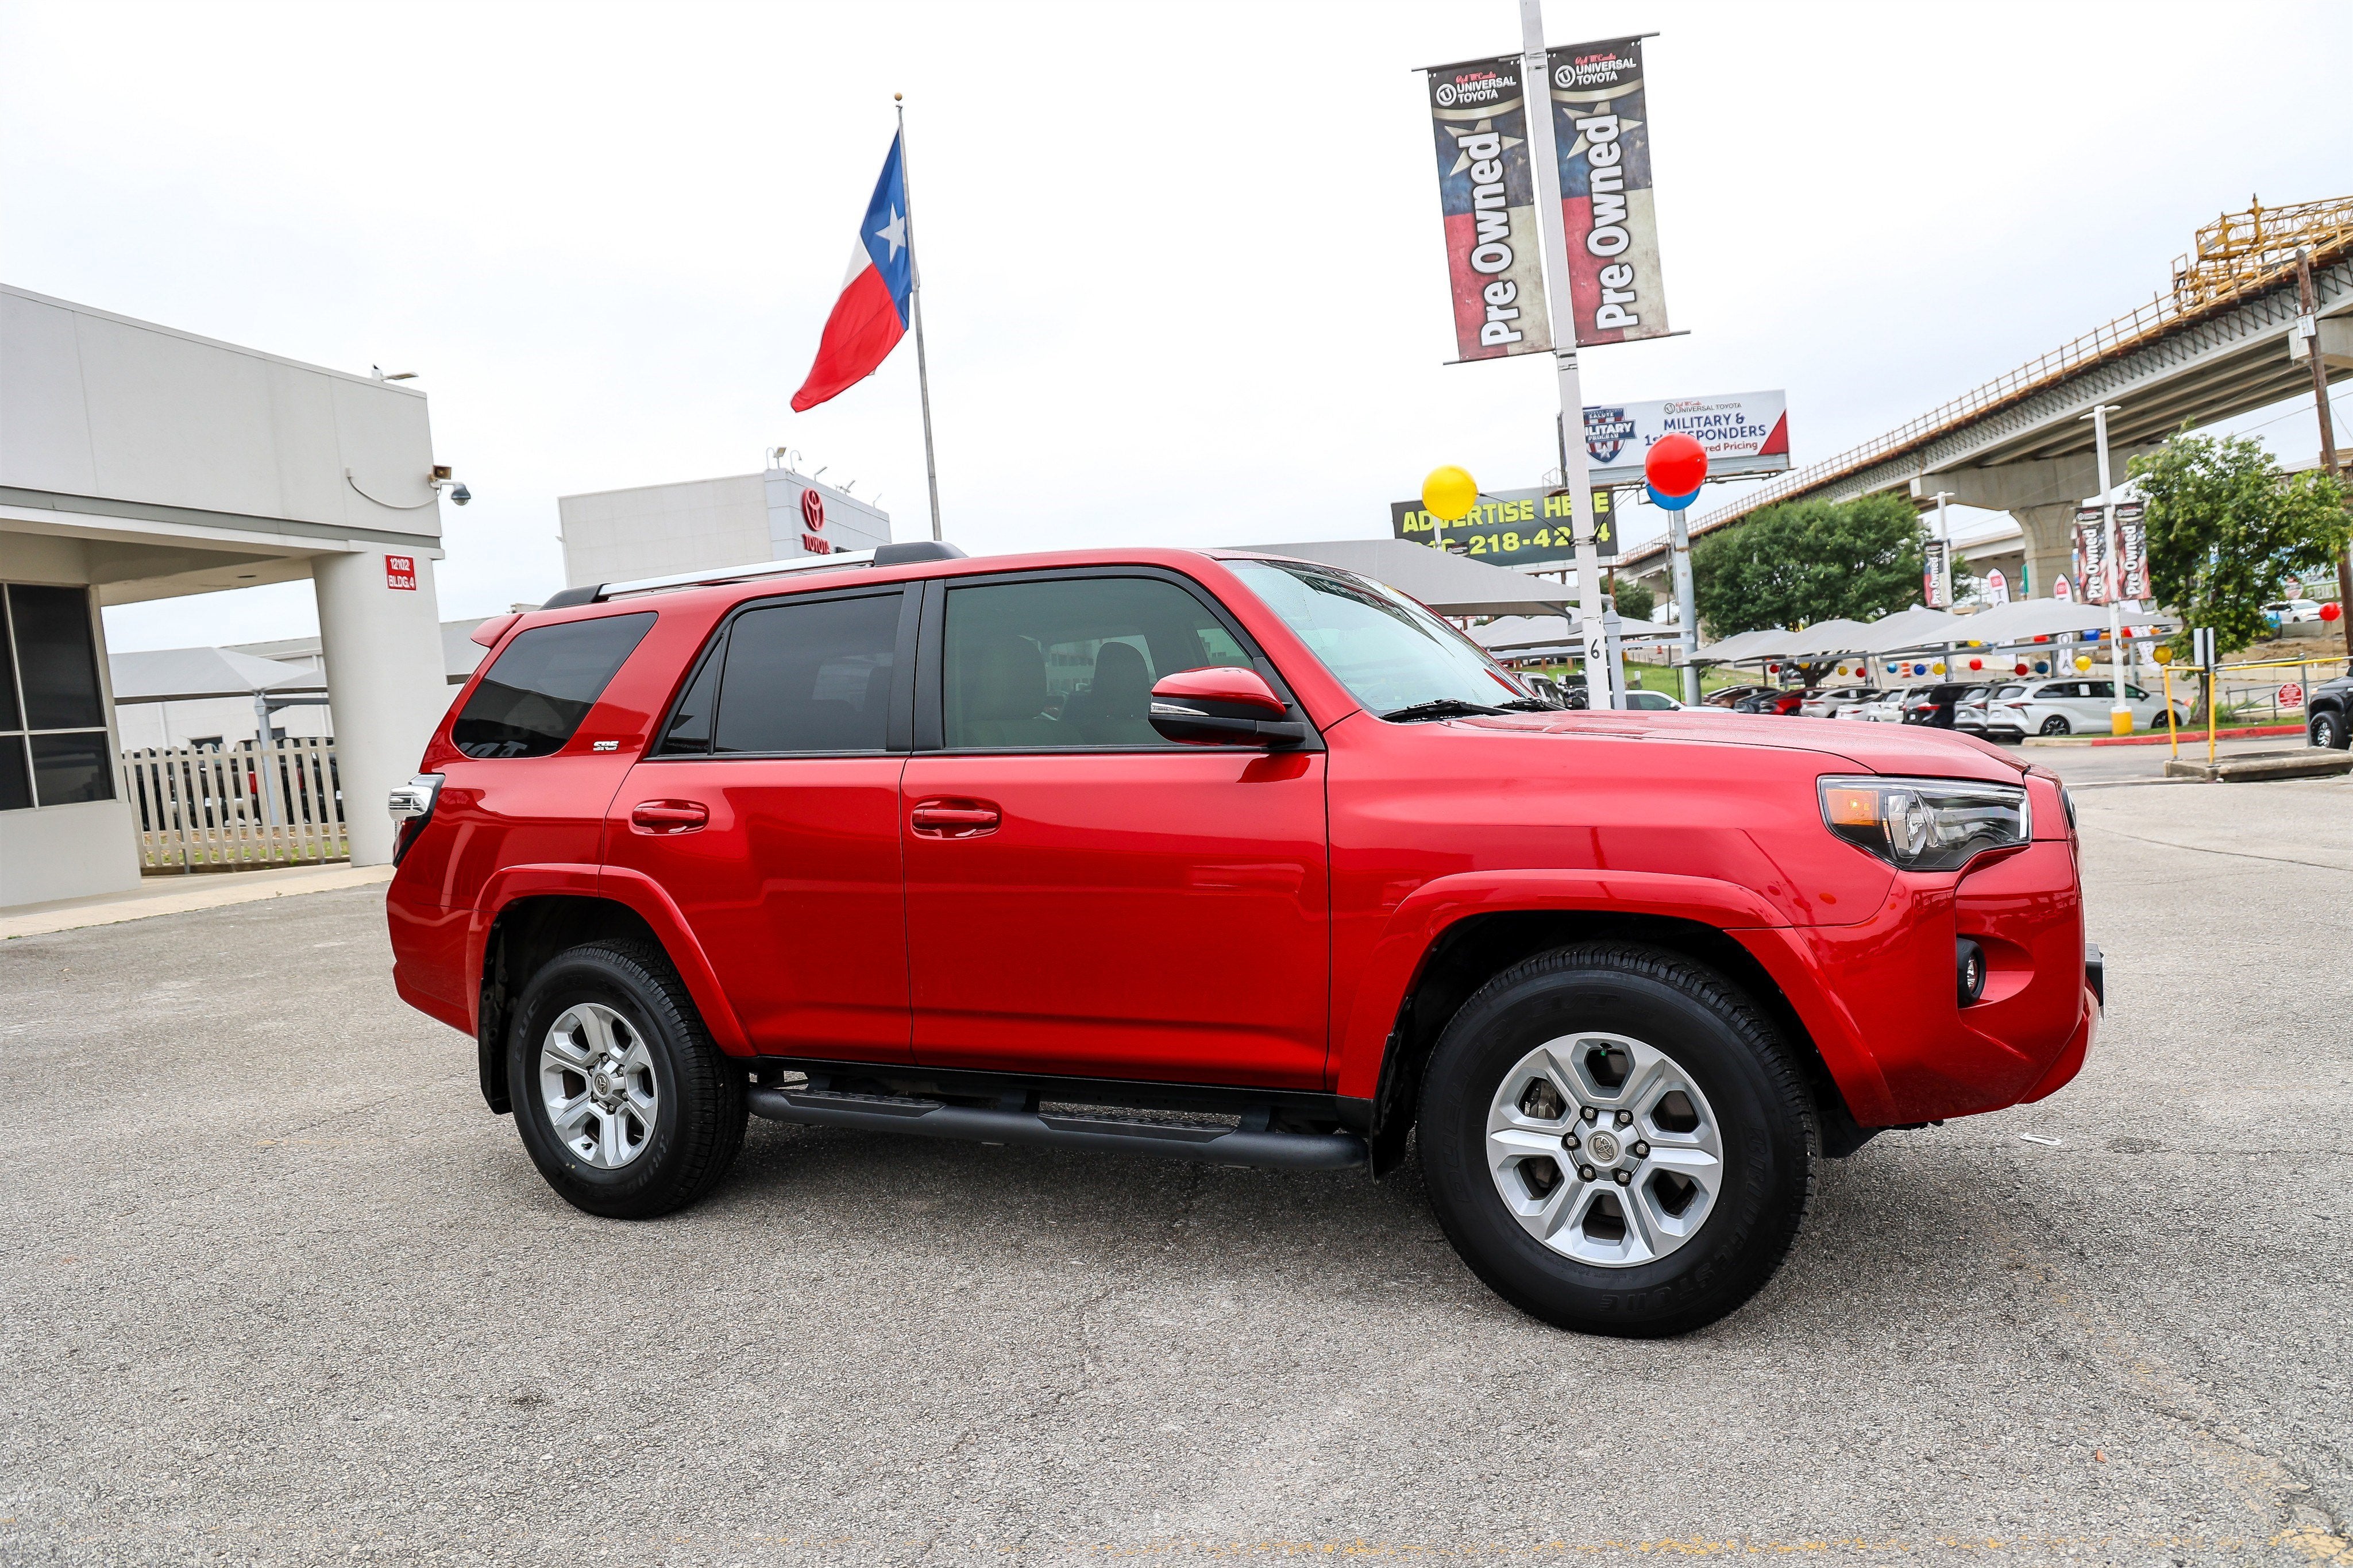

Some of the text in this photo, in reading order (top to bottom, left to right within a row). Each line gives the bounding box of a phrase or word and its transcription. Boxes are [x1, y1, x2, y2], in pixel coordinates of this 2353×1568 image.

[1576, 57, 1637, 75] UNIVERSAL
[1457, 76, 1517, 94] UNIVERSAL
[1576, 71, 1618, 86] TOYOTA
[1458, 89, 1498, 104] TOYOTA
[1576, 114, 1639, 330] Pre Owned
[1458, 132, 1522, 346] Pre Owned
[1676, 404, 1715, 413] UNIVERSAL
[1585, 422, 1632, 436] ILITARY
[1664, 412, 1745, 430] MILITARY &
[1588, 432, 1619, 441] PROGRAM
[1724, 441, 1758, 451] Pricing
[1544, 492, 1609, 518] HEE
[802, 533, 831, 555] TOYOTA
[2082, 528, 2100, 574] Owned
[2121, 525, 2138, 571] Owned
[390, 558, 411, 570] 12102
[409, 577, 414, 588] 4
[2087, 576, 2103, 599] Pre
[2126, 573, 2141, 595] Pre
[1590, 638, 1600, 659] 6
